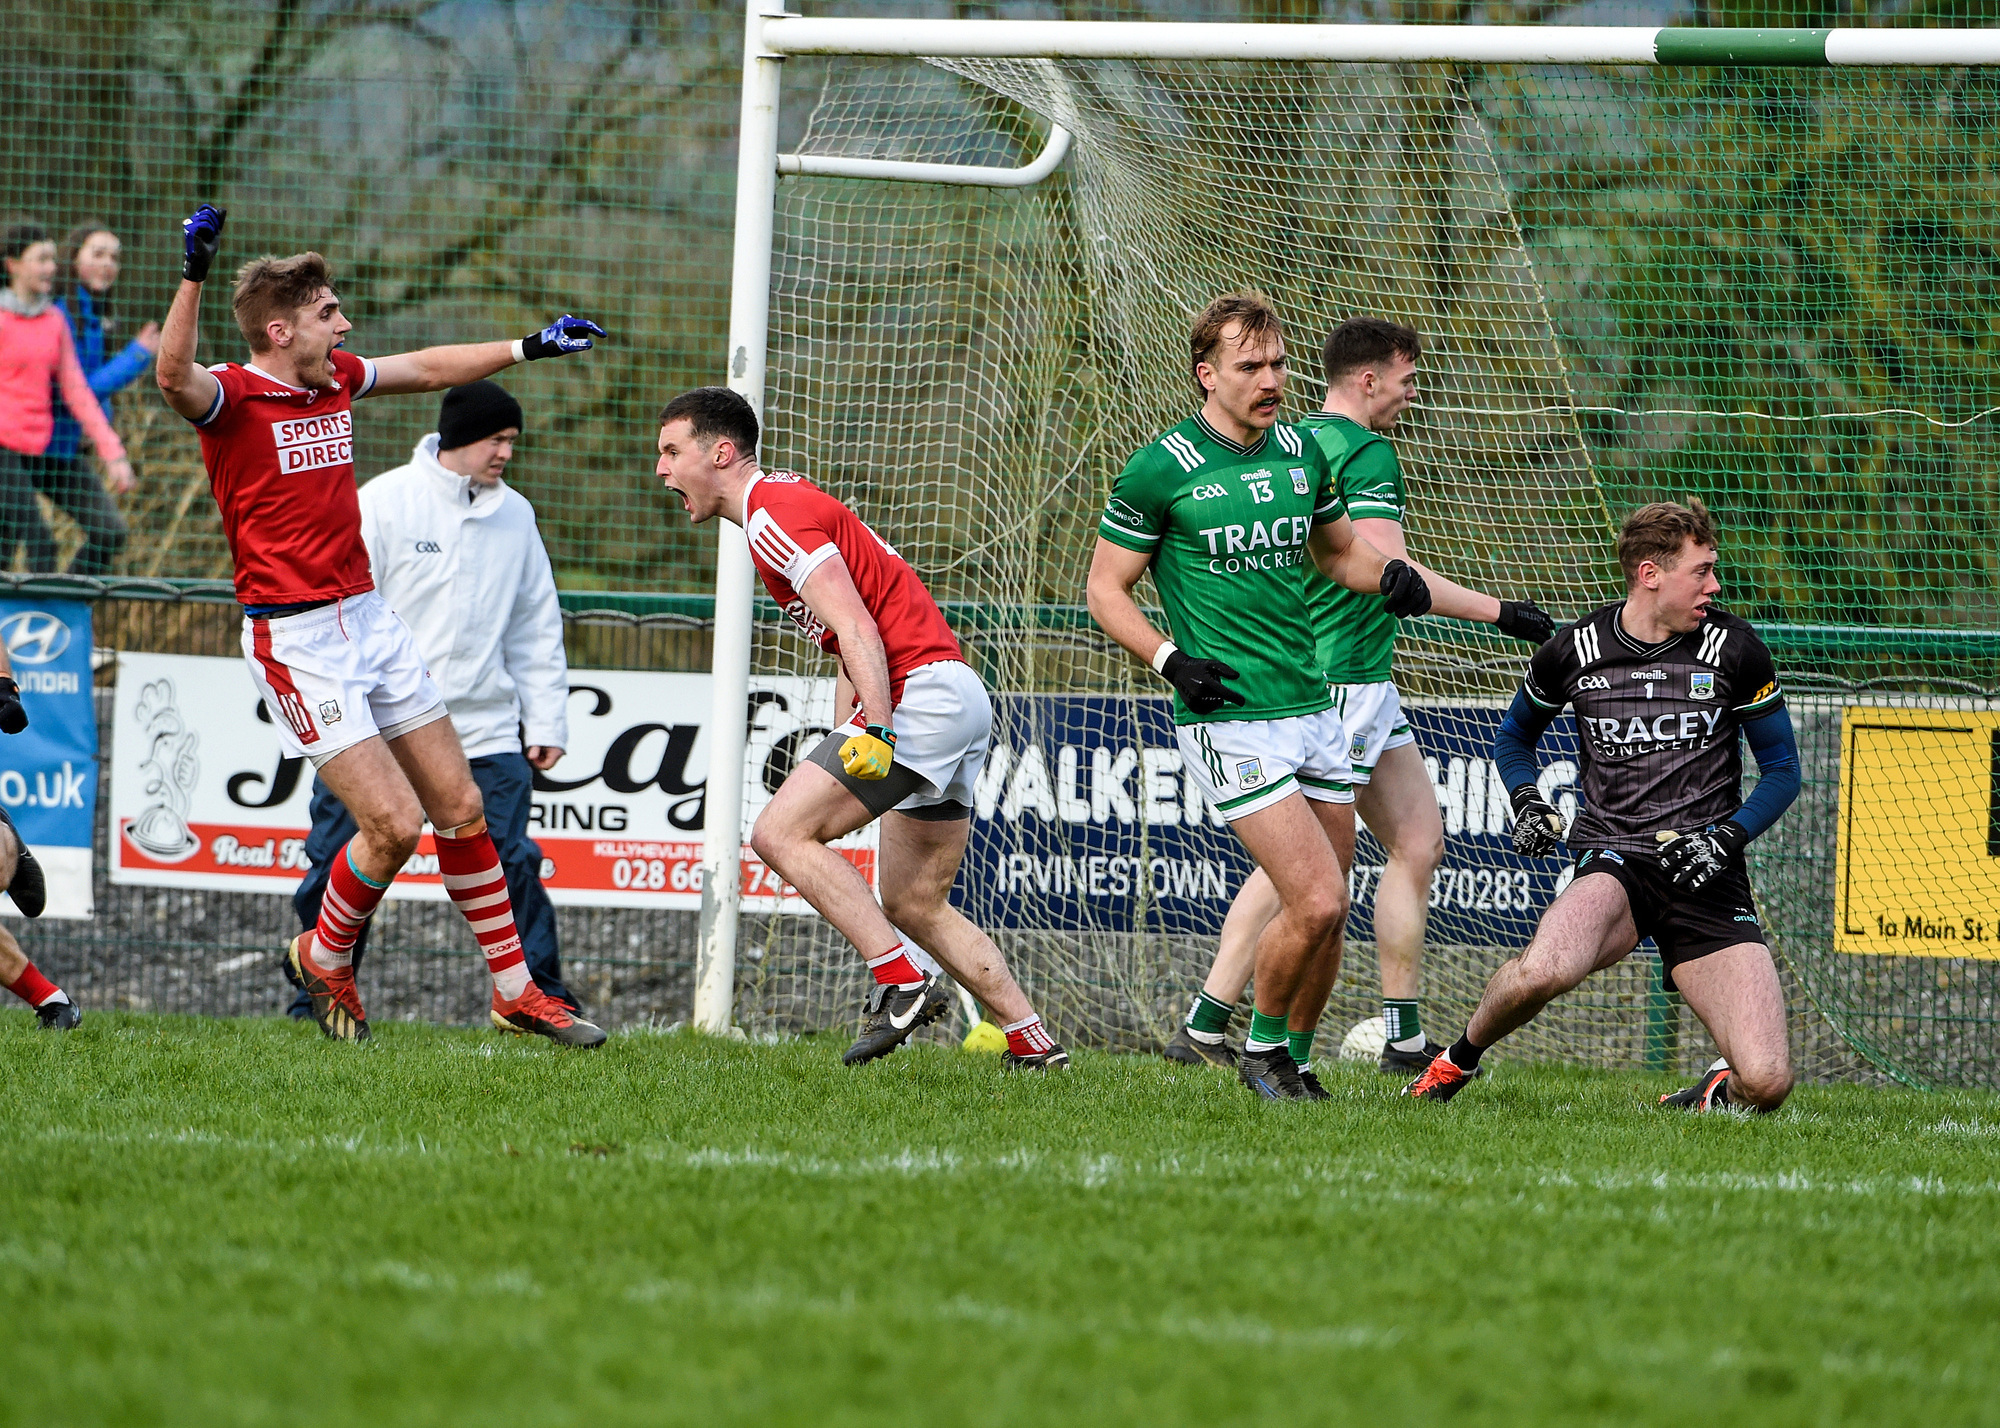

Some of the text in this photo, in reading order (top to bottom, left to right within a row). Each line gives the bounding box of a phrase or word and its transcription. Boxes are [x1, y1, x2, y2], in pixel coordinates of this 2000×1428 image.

[281, 414, 351, 443] SPORTS
[1248, 480, 1274, 504] 13
[1199, 515, 1312, 555] TRACEY
[1209, 549, 1304, 574] CONCRETE
[14, 670, 79, 694] UNDAI
[1643, 682, 1654, 699] 1
[1583, 707, 1723, 744] TRACEY
[530, 804, 627, 831] RING
[212, 834, 276, 868] Real
[612, 858, 666, 890] 028
[999, 853, 1226, 899] IRVINESTOWN
[1904, 915, 1956, 939] Main
[1963, 917, 1990, 941] St.
